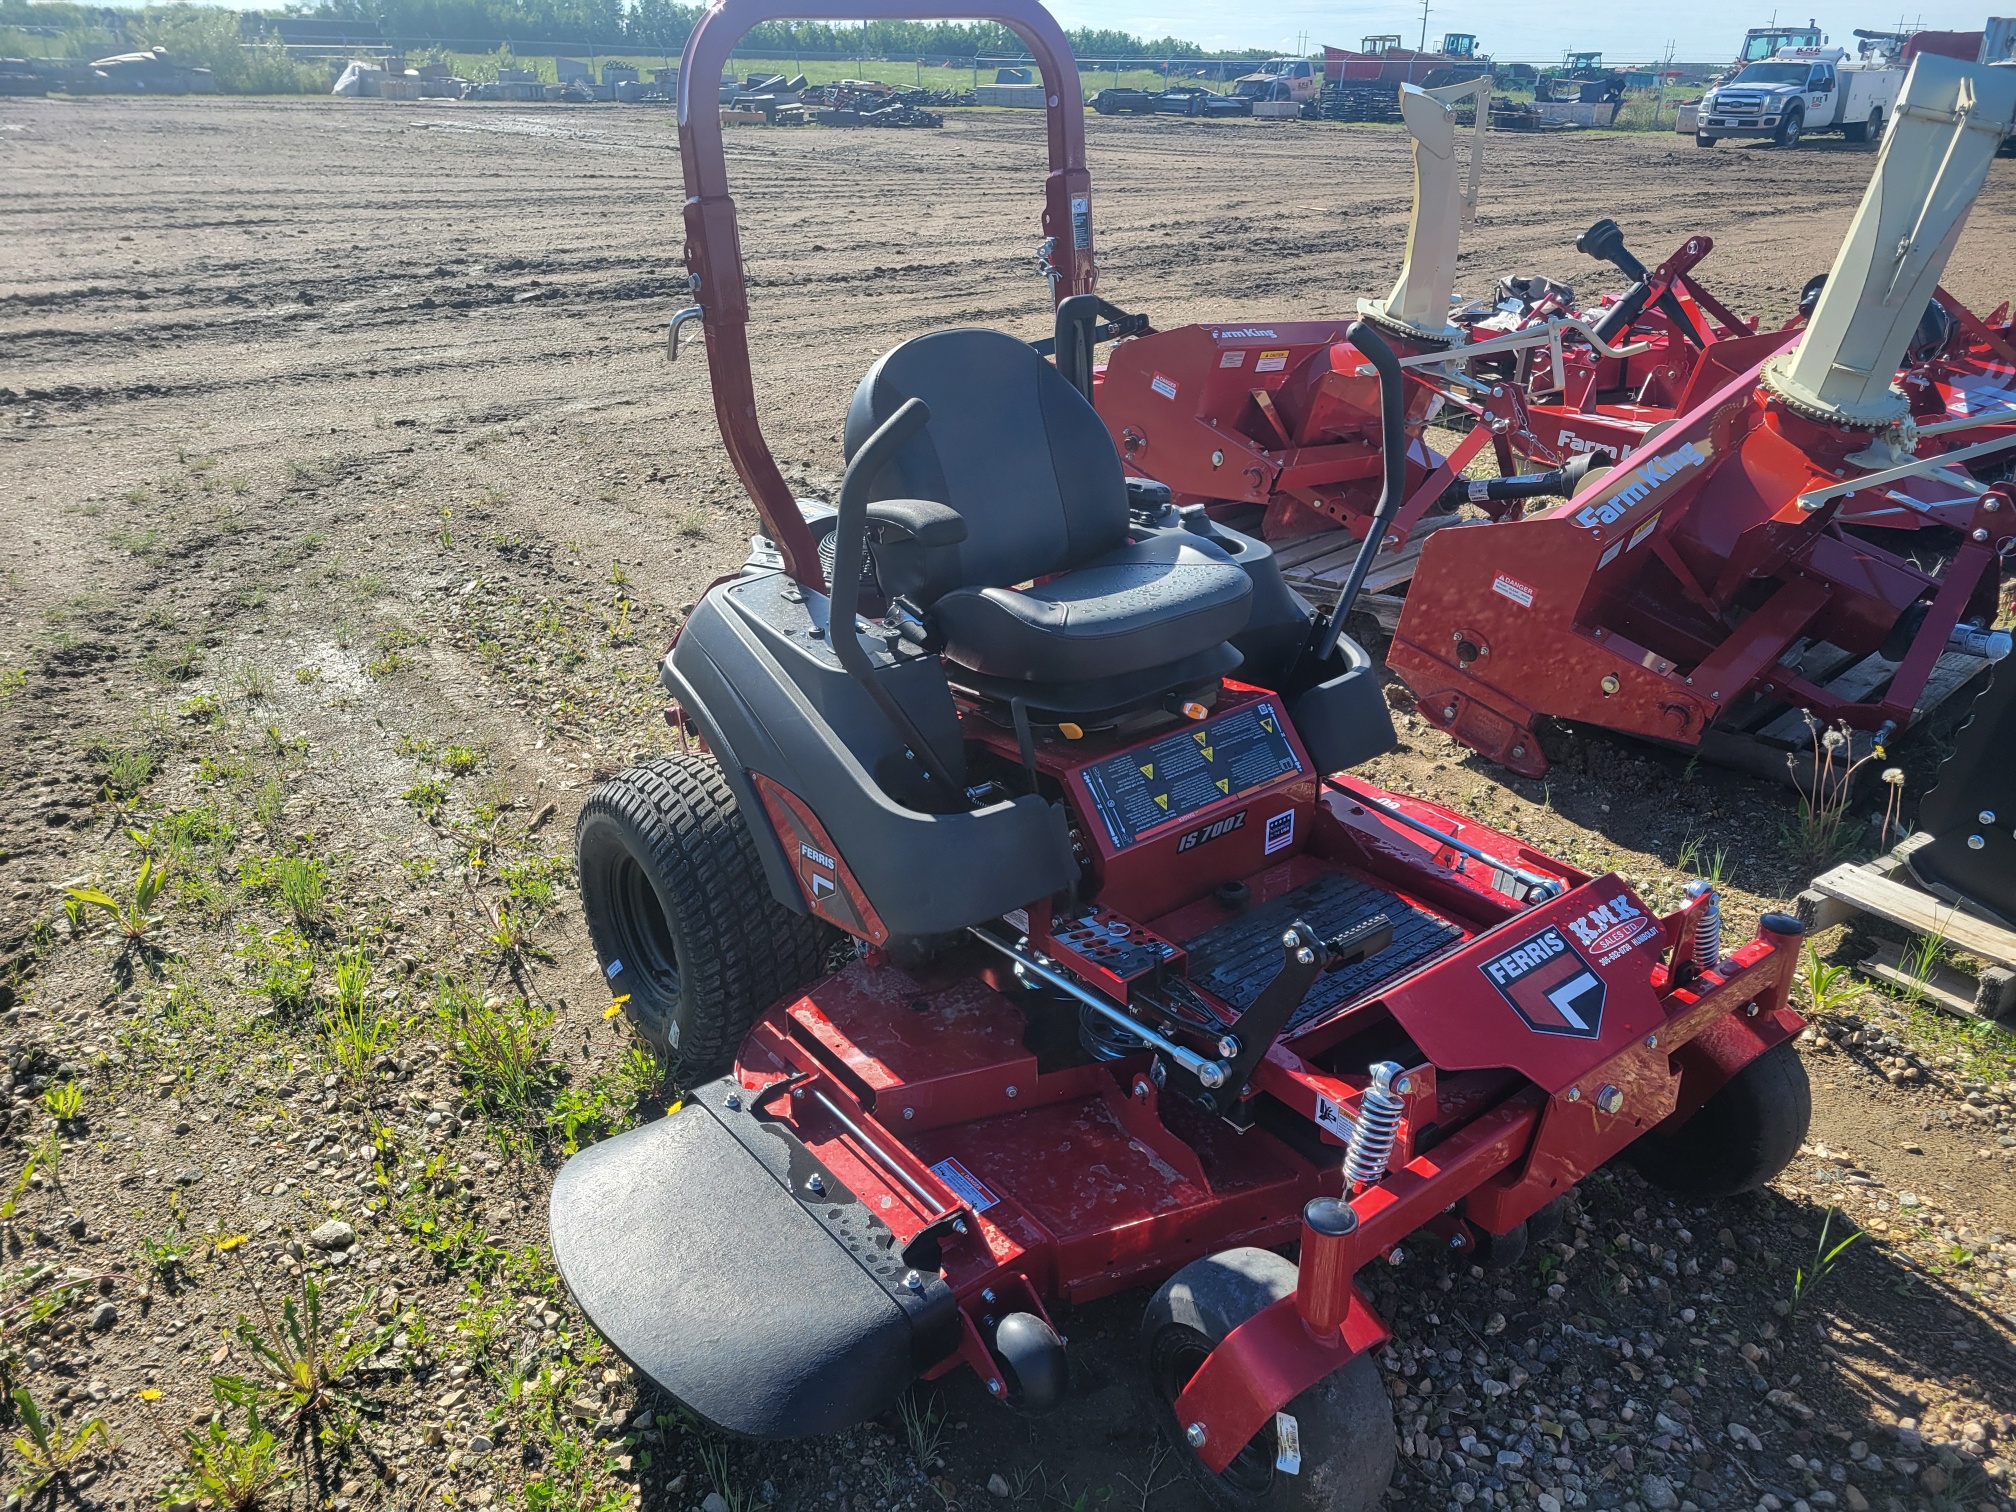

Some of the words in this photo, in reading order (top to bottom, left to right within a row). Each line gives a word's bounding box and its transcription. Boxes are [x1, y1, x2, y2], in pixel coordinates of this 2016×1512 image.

[1243, 328, 1278, 339] King
[1557, 429, 1618, 459] Farm
[1576, 480, 1650, 533] Farm
[1636, 441, 1705, 489] King
[1505, 577, 1534, 595] DANGER
[1178, 831, 1199, 852] IS
[1200, 811, 1247, 843] 700Z
[801, 844, 835, 870] FERRIS
[1600, 930, 1624, 949] SALES
[1631, 926, 1659, 947] HUMBOLDT
[1487, 931, 1565, 985] FERRIS
[964, 1174, 983, 1190] DANGER
